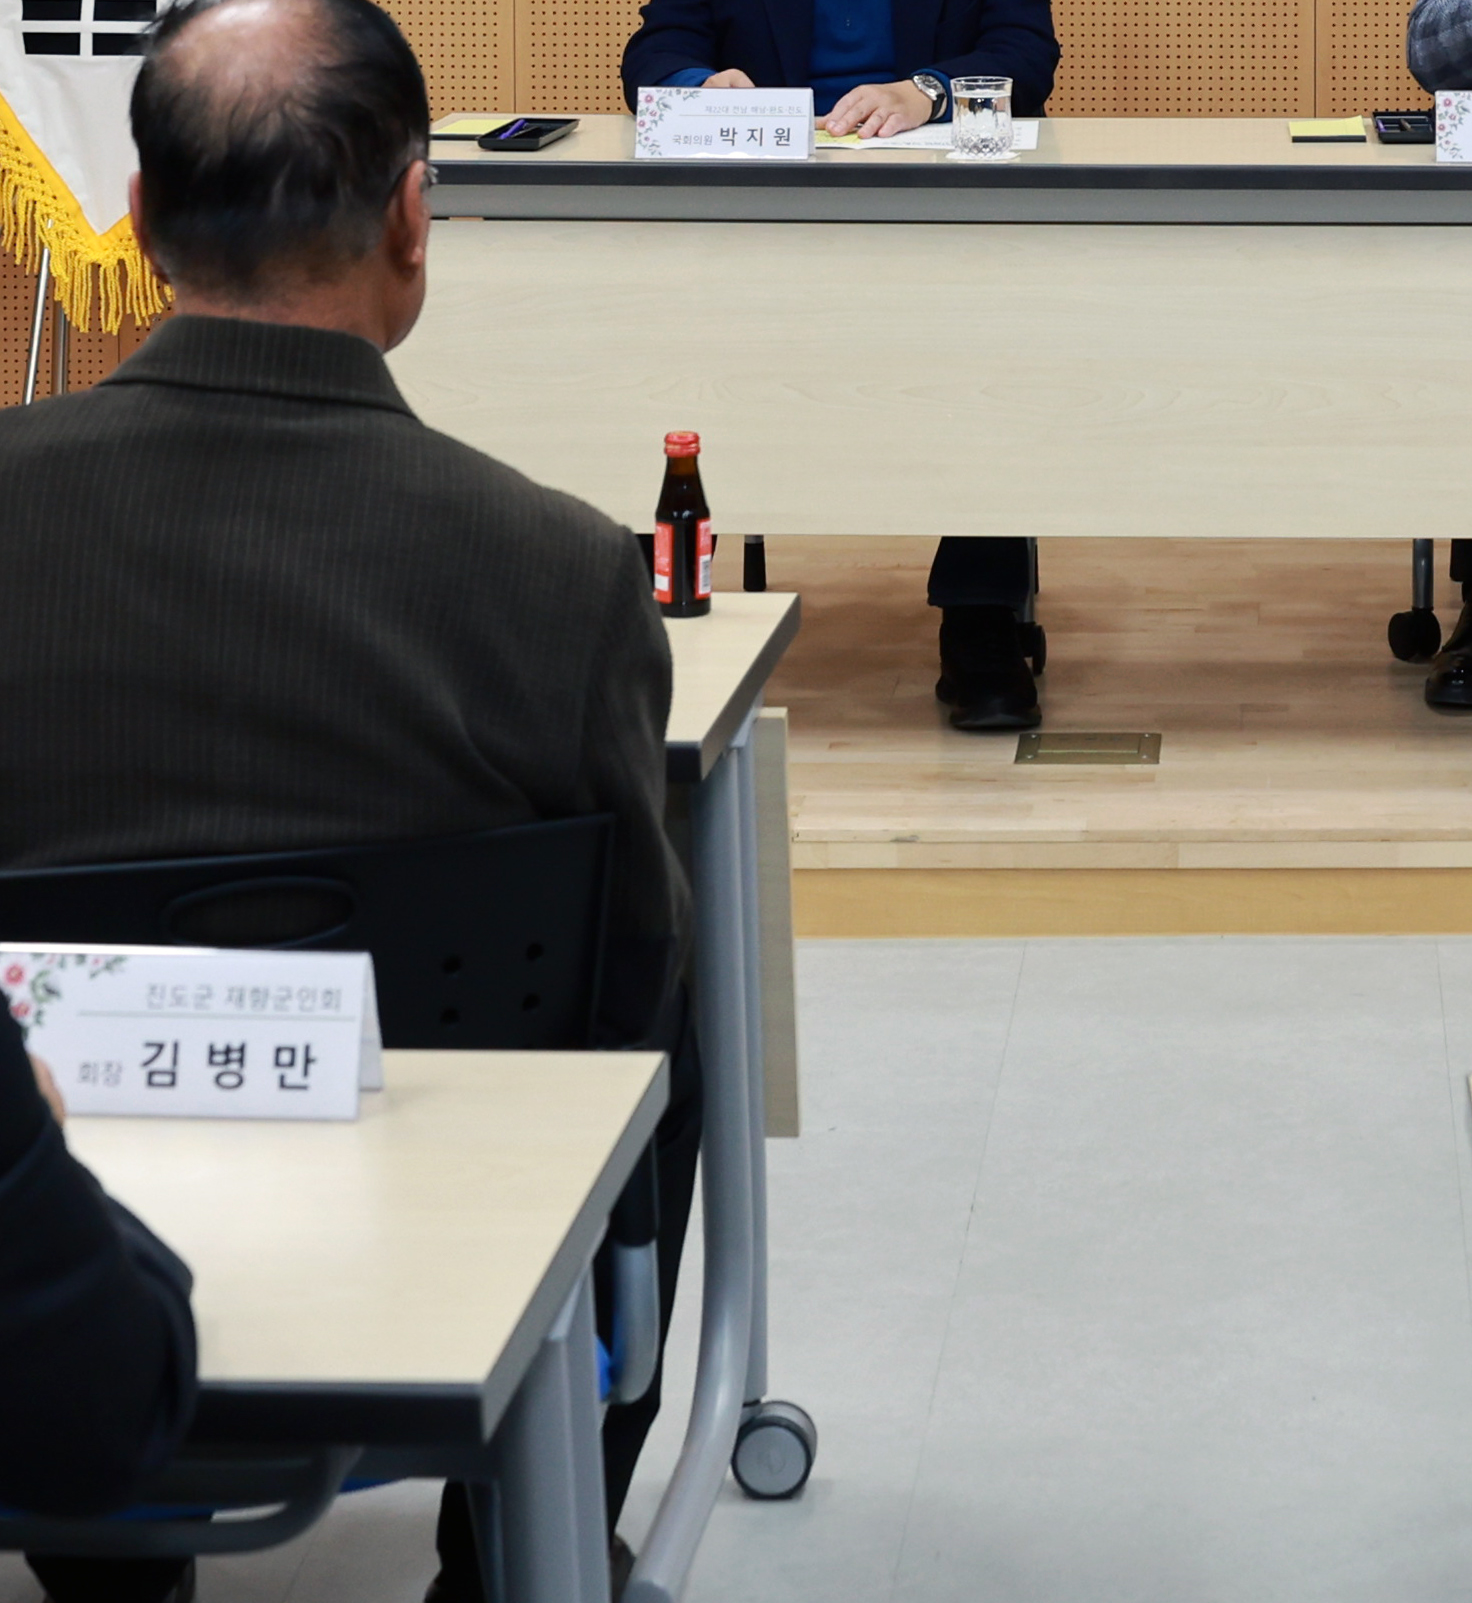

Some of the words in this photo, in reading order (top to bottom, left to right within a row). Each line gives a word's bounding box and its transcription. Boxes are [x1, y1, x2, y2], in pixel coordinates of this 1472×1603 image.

[672, 134, 713, 146] 국회의원
[145, 982, 215, 1012] 진도군
[225, 984, 343, 1014] 재향군인회
[78, 1060, 124, 1088] 회장
